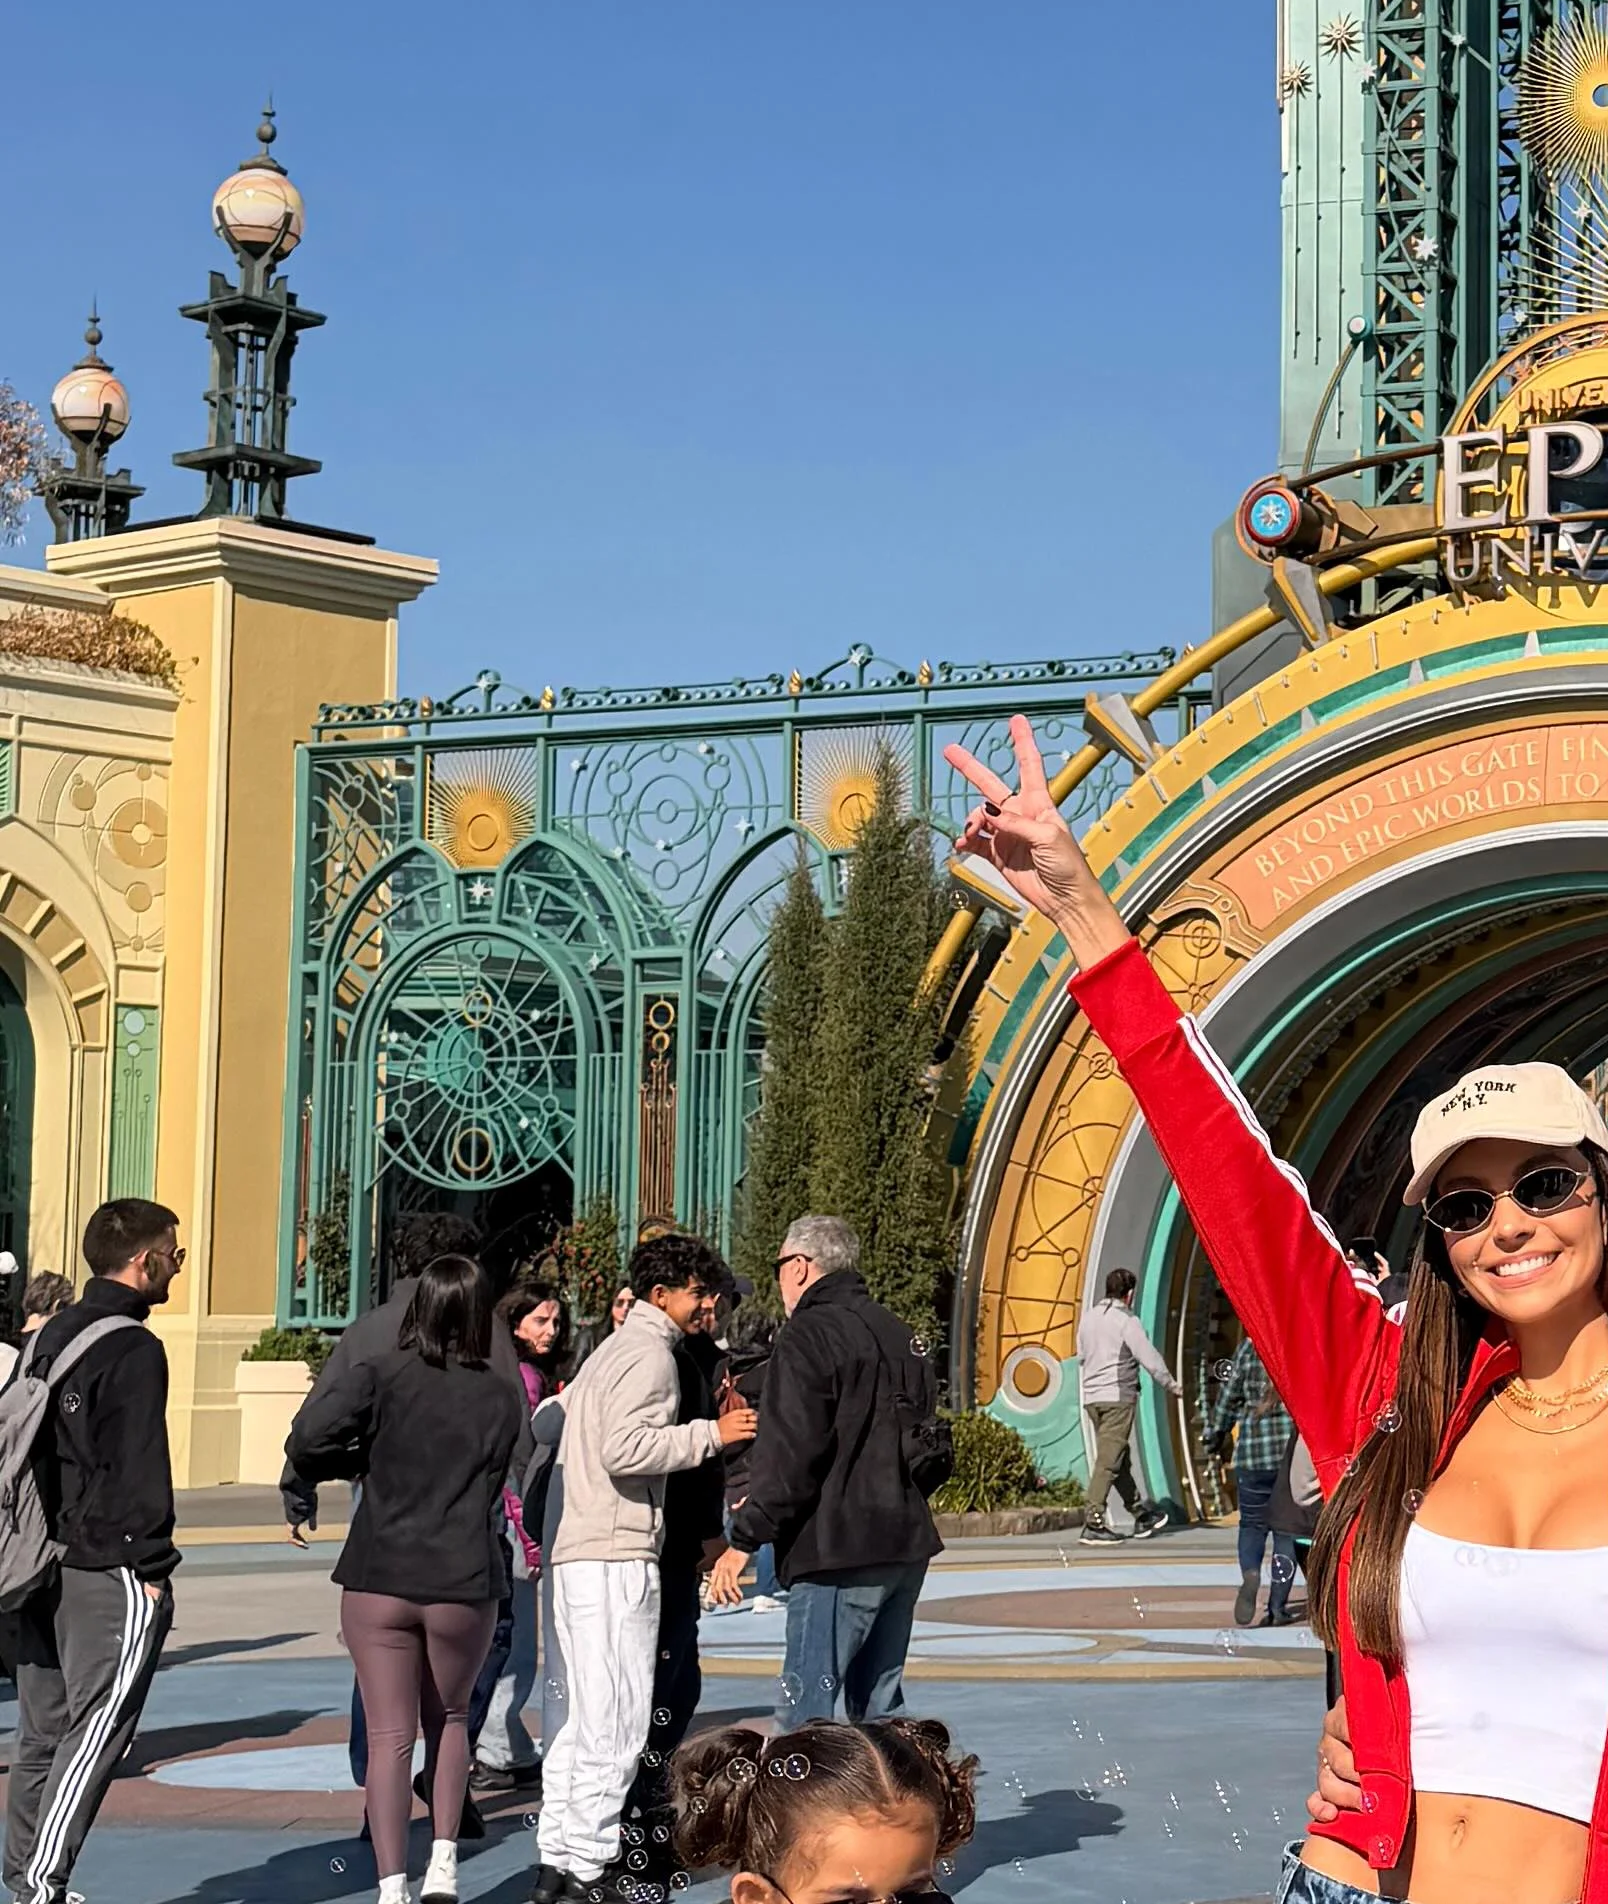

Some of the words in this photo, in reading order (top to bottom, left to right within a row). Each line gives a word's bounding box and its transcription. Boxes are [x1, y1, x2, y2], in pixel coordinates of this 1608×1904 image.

[1254, 793, 1374, 877] BEYOND
[1378, 759, 1453, 806] THIS
[1460, 741, 1541, 778] GATE
[1270, 854, 1335, 911] AND
[1339, 814, 1408, 864] EPIC
[1410, 775, 1542, 830] WORLDS
[1559, 771, 1600, 798] TO
[1441, 1087, 1467, 1116] NEW
[1475, 1081, 1517, 1093] YORK
